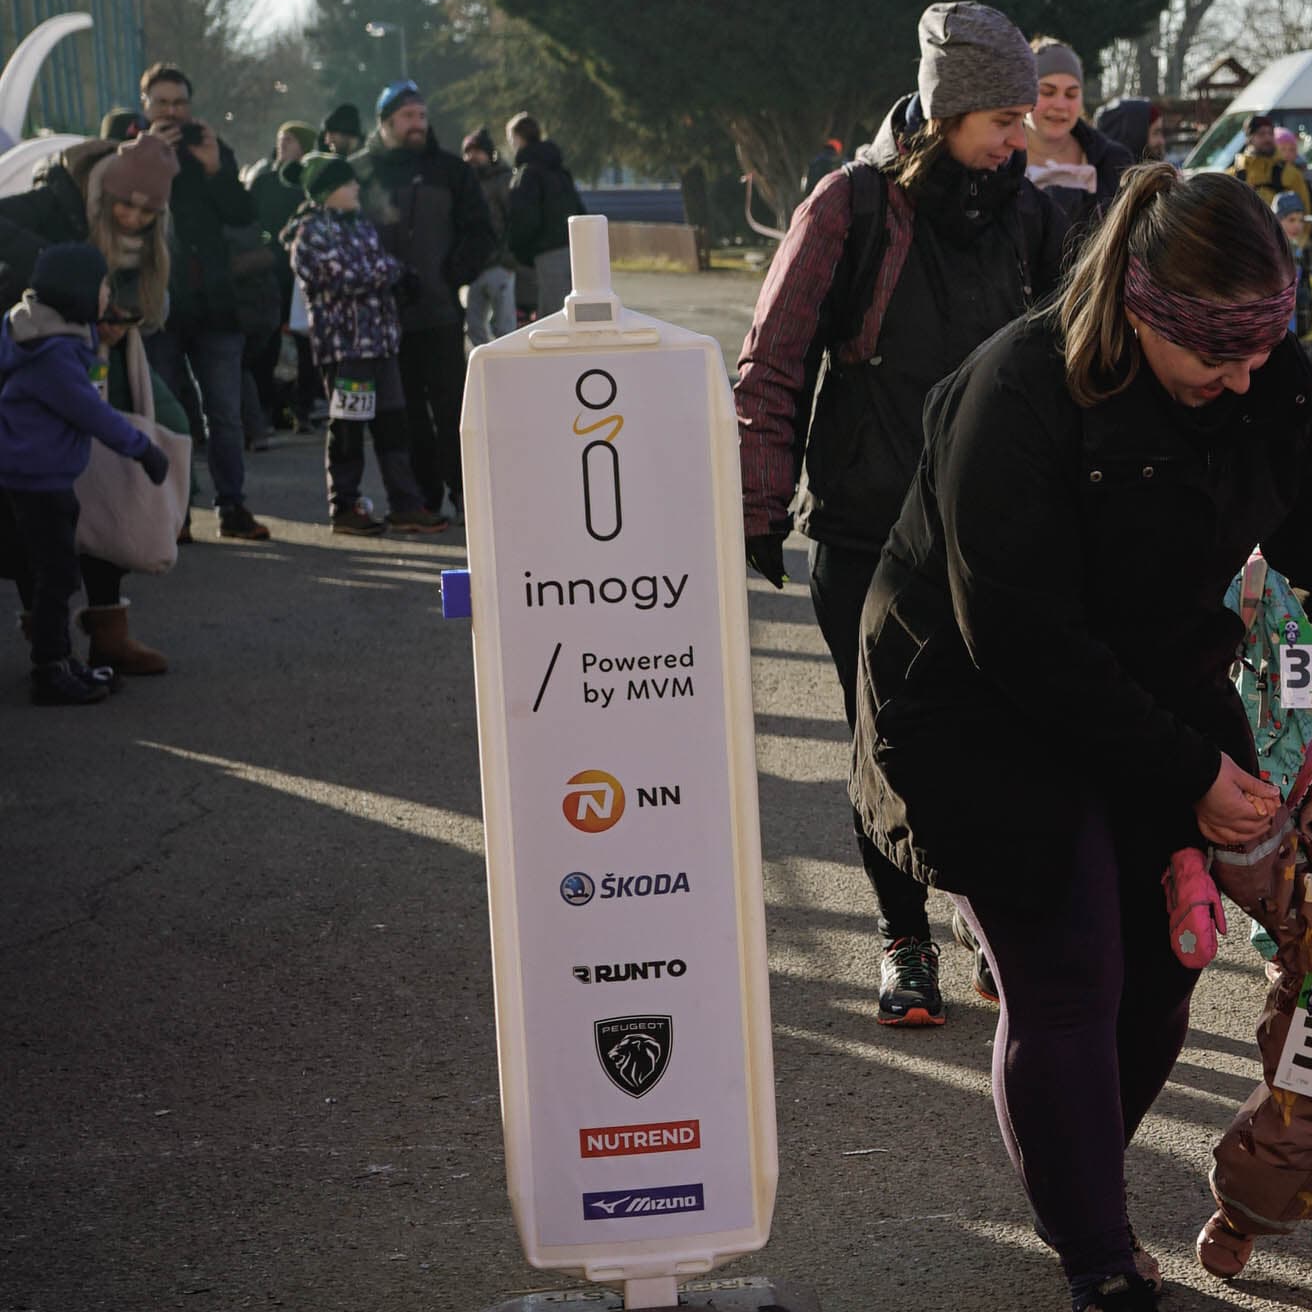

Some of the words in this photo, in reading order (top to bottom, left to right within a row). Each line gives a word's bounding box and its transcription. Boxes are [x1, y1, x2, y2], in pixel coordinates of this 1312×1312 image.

[524, 571, 689, 610] innogy
[582, 645, 694, 673] Powered
[583, 682, 614, 708] by
[627, 677, 694, 701] MVM
[637, 785, 681, 807] NN
[600, 872, 690, 899] ŠKODA
[595, 959, 687, 983] RUNTO
[602, 1022, 665, 1034] PEUGEOT
[587, 1127, 695, 1152] NUTREND
